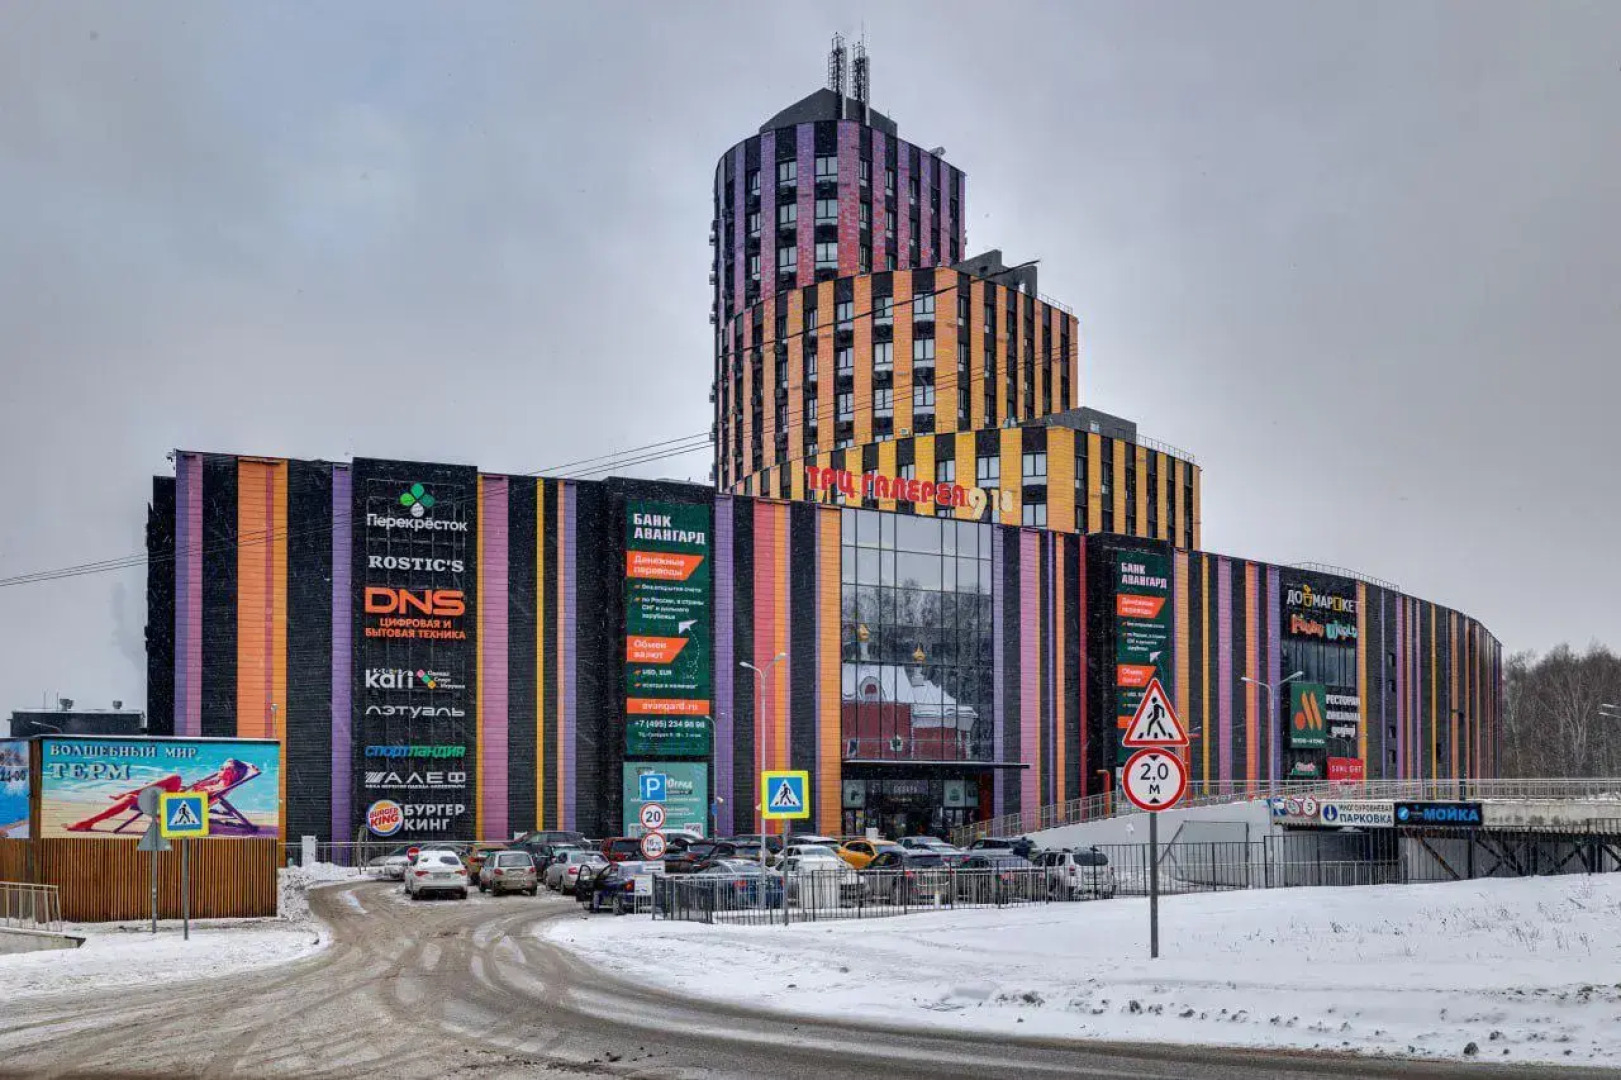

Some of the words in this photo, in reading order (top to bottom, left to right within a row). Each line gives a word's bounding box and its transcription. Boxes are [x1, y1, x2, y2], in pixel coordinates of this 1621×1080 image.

[806, 466, 855, 499] ТРЦ
[366, 513, 468, 532] Перекрёсток
[633, 513, 671, 527] БАНК
[634, 527, 706, 545] АВАНГАРД
[368, 555, 465, 573] ROSTIC'S
[1121, 562, 1146, 575] БАНК
[1121, 574, 1167, 589] АВАНГАРД
[364, 587, 465, 616] DNS
[379, 618, 441, 628] ЦИФРОВАЯ
[443, 619, 452, 628] И
[365, 628, 415, 639] БЫТОВАЯ
[418, 629, 466, 640] ТЕХНИКА
[633, 640, 667, 649] Обмен
[365, 669, 414, 689] kari
[50, 743, 157, 758] ВОЛШЕБНЫЙ
[165, 747, 197, 759] МИР
[50, 762, 130, 780] ТЕРМ
[384, 771, 466, 784] АЛЕФ
[1140, 762, 1169, 782] 2,0
[404, 804, 466, 817] БУРГЕР
[1306, 802, 1313, 812] 5
[369, 813, 400, 827] KING
[645, 810, 661, 823] 20
[1339, 813, 1393, 825] ПАРКОВКА
[1424, 808, 1480, 822] МОЙКА
[404, 818, 451, 831] КИНГ
